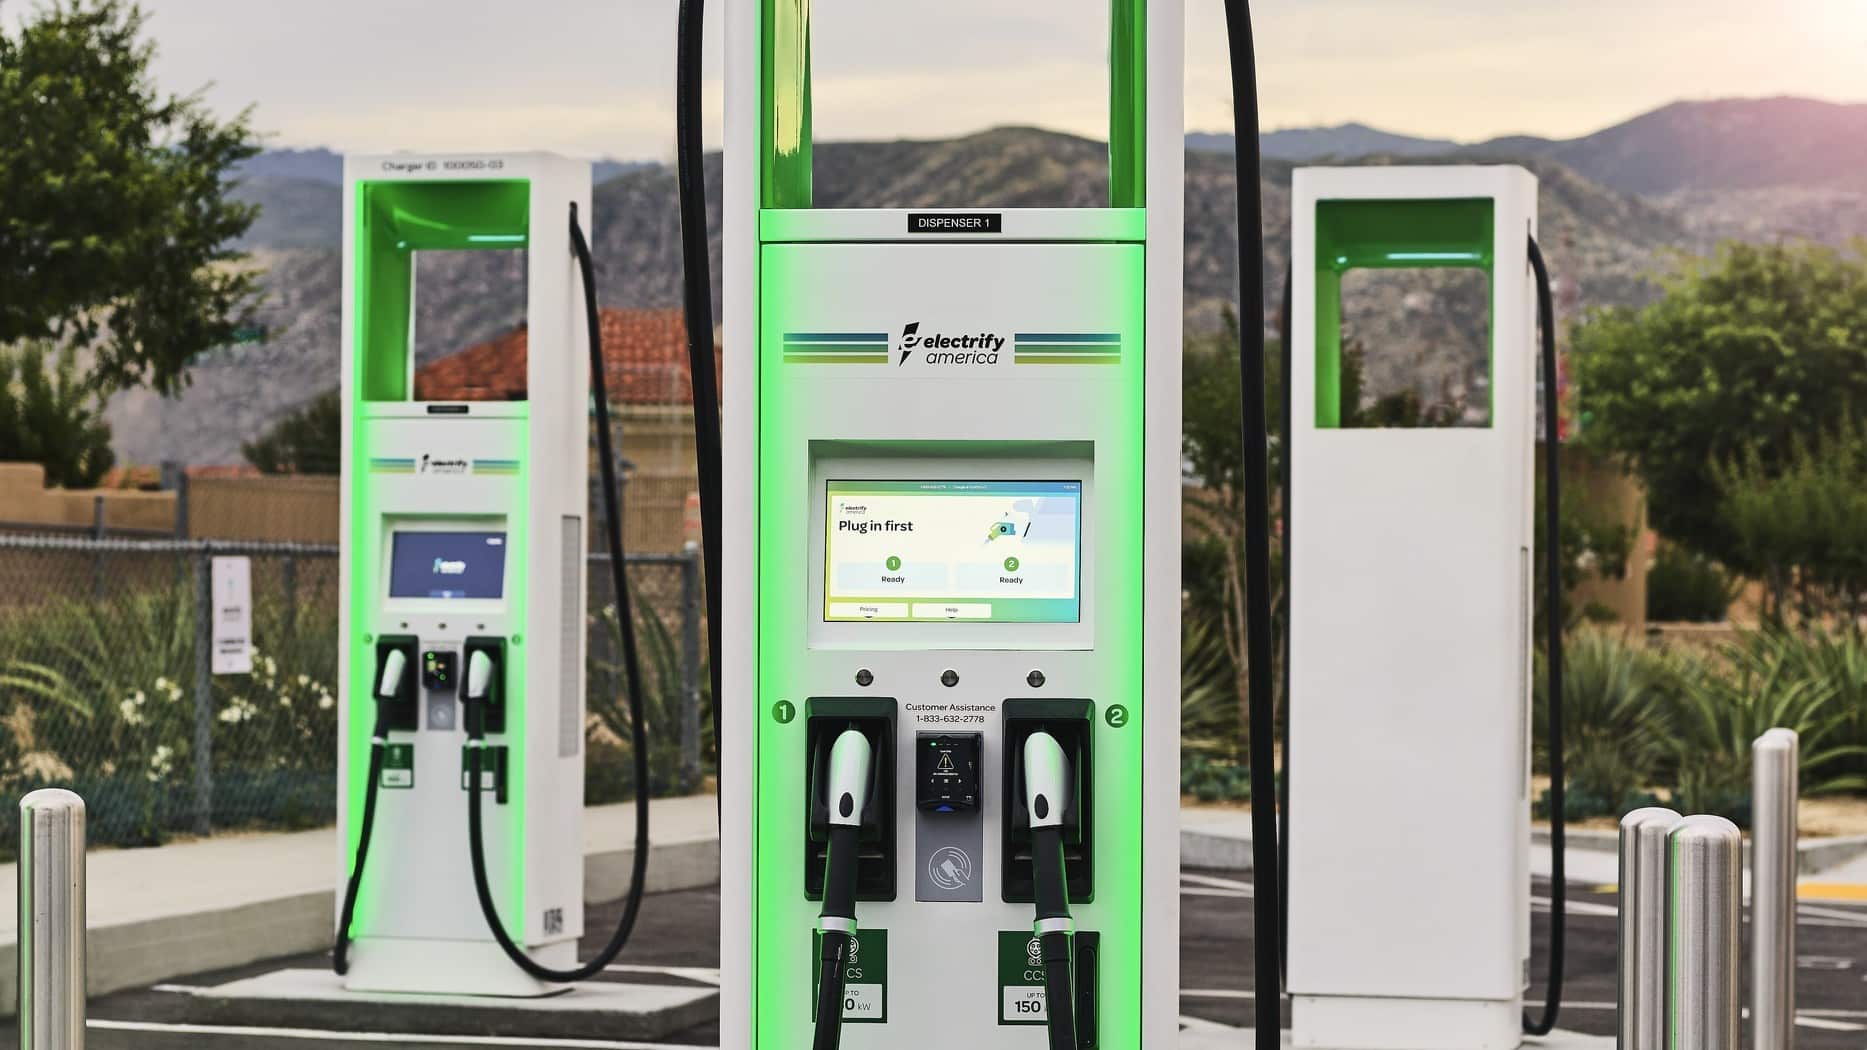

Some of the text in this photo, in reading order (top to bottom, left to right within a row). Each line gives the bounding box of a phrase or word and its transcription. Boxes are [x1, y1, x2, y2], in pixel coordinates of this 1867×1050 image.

[918, 217, 990, 228] DISPENSER 1
[923, 332, 1005, 352] electrify
[926, 349, 999, 365] america
[839, 520, 914, 534] Plug in first
[881, 575, 905, 584] Ready
[999, 575, 1023, 585] Ready
[905, 702, 996, 712] Customer Assistance
[916, 714, 985, 723] 1-833-632-2778
[1110, 708, 1123, 723] 2
[857, 1002, 872, 1011] kW
[1015, 1000, 1041, 1013] 150
